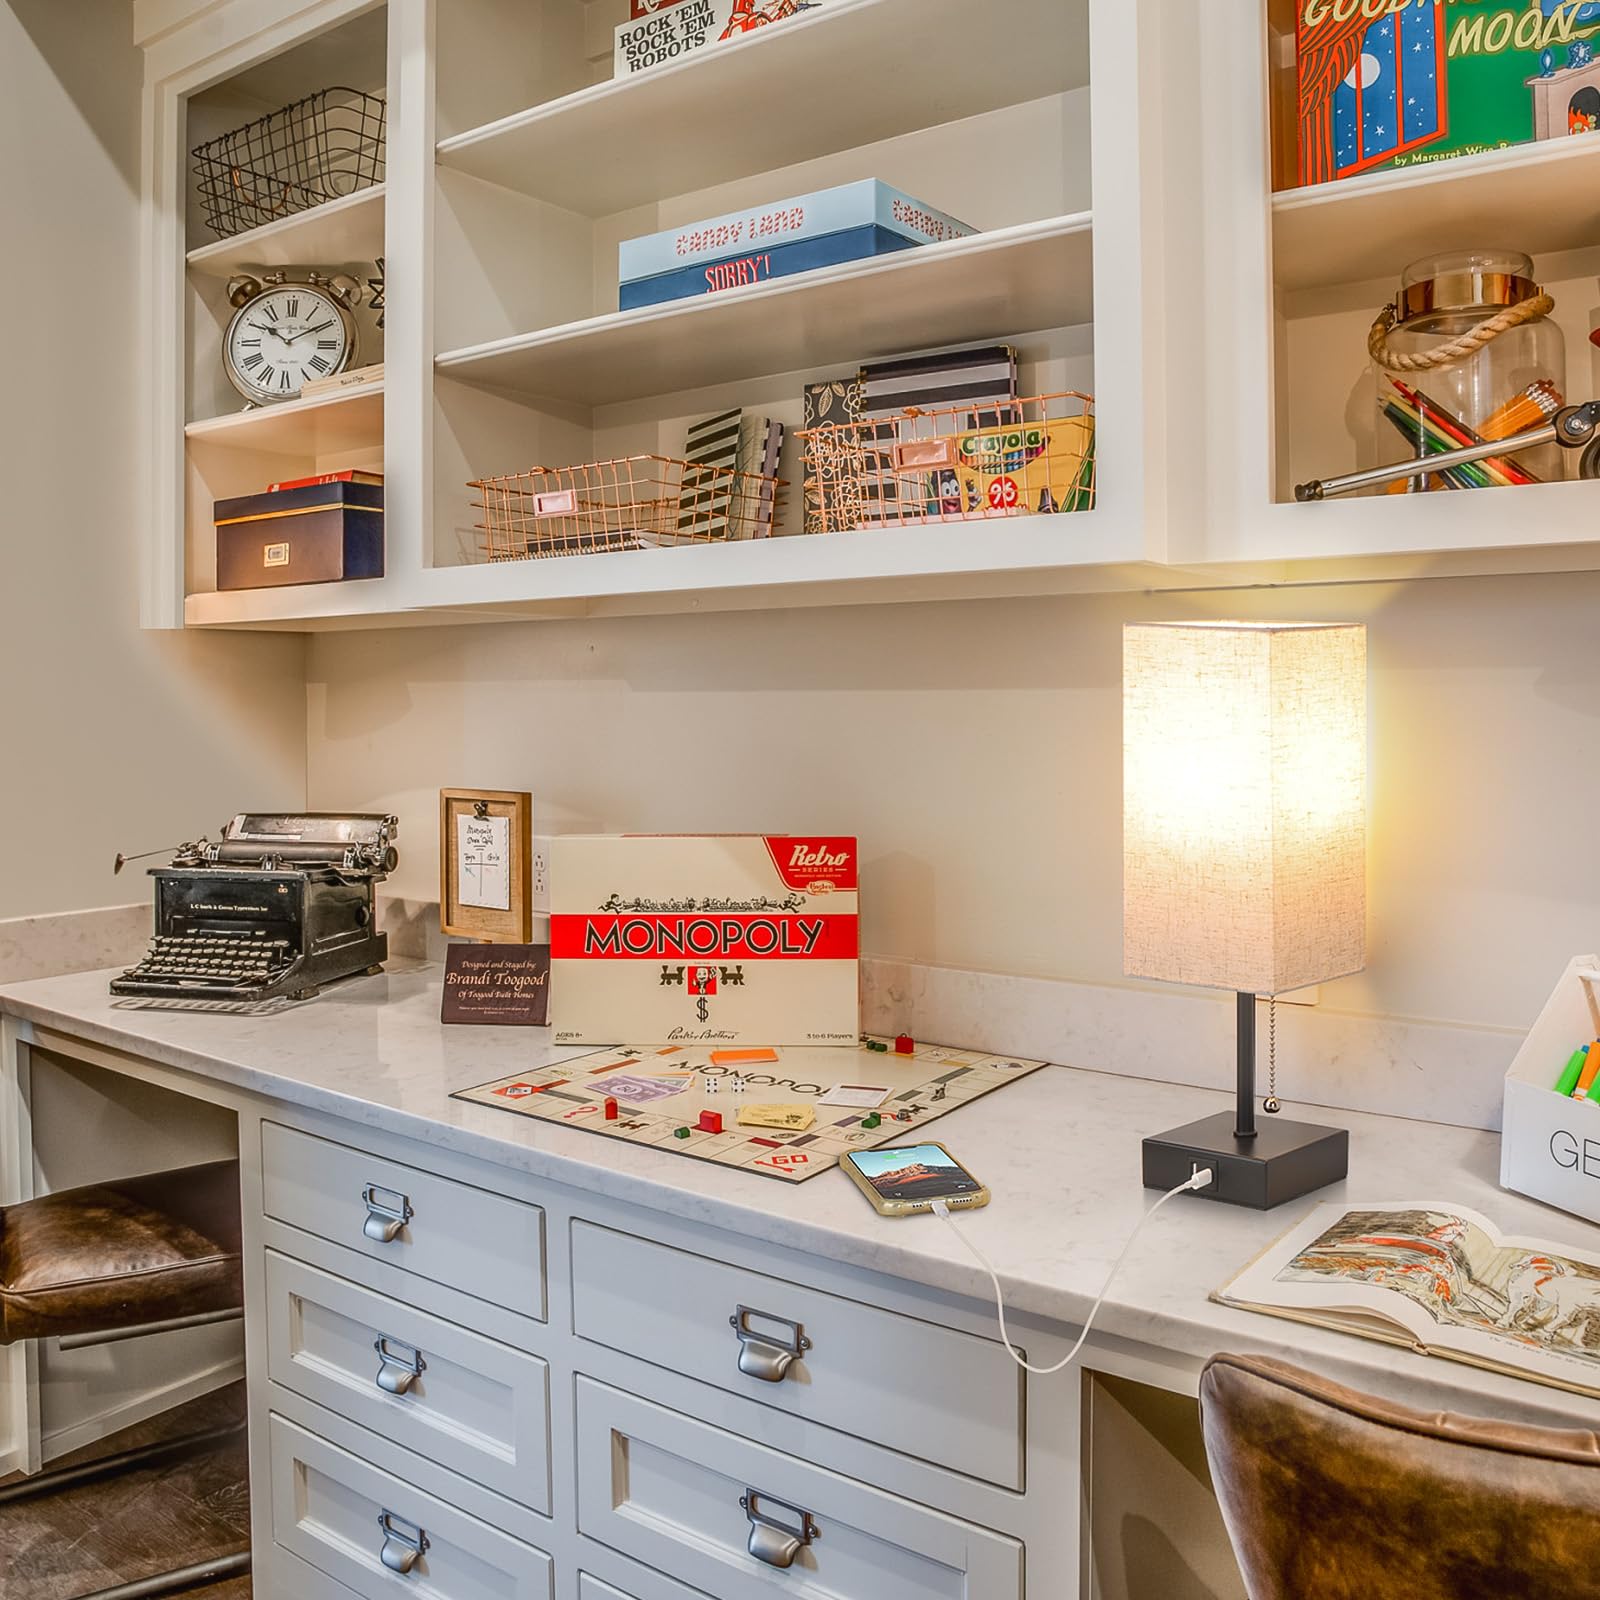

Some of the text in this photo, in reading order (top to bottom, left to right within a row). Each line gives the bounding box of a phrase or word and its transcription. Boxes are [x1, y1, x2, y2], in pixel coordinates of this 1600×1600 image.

[619, 0, 712, 49] ROCK 'EM
[626, 11, 716, 61] SOCK 'EM
[1448, 2, 1584, 57] MOON
[629, 31, 707, 73] ROBOTS
[1394, 156, 1407, 166] by
[676, 207, 804, 256] CANDY LAND
[704, 254, 771, 294] SORRY!
[962, 430, 1041, 456] Crayola
[989, 481, 1017, 505] 96
[788, 844, 851, 867] Retro
[584, 919, 825, 955] MONOPOLY
[446, 970, 549, 991] Brandi Toogood
[669, 1060, 831, 1098] MONOPOL
[771, 1154, 809, 1165] GO
